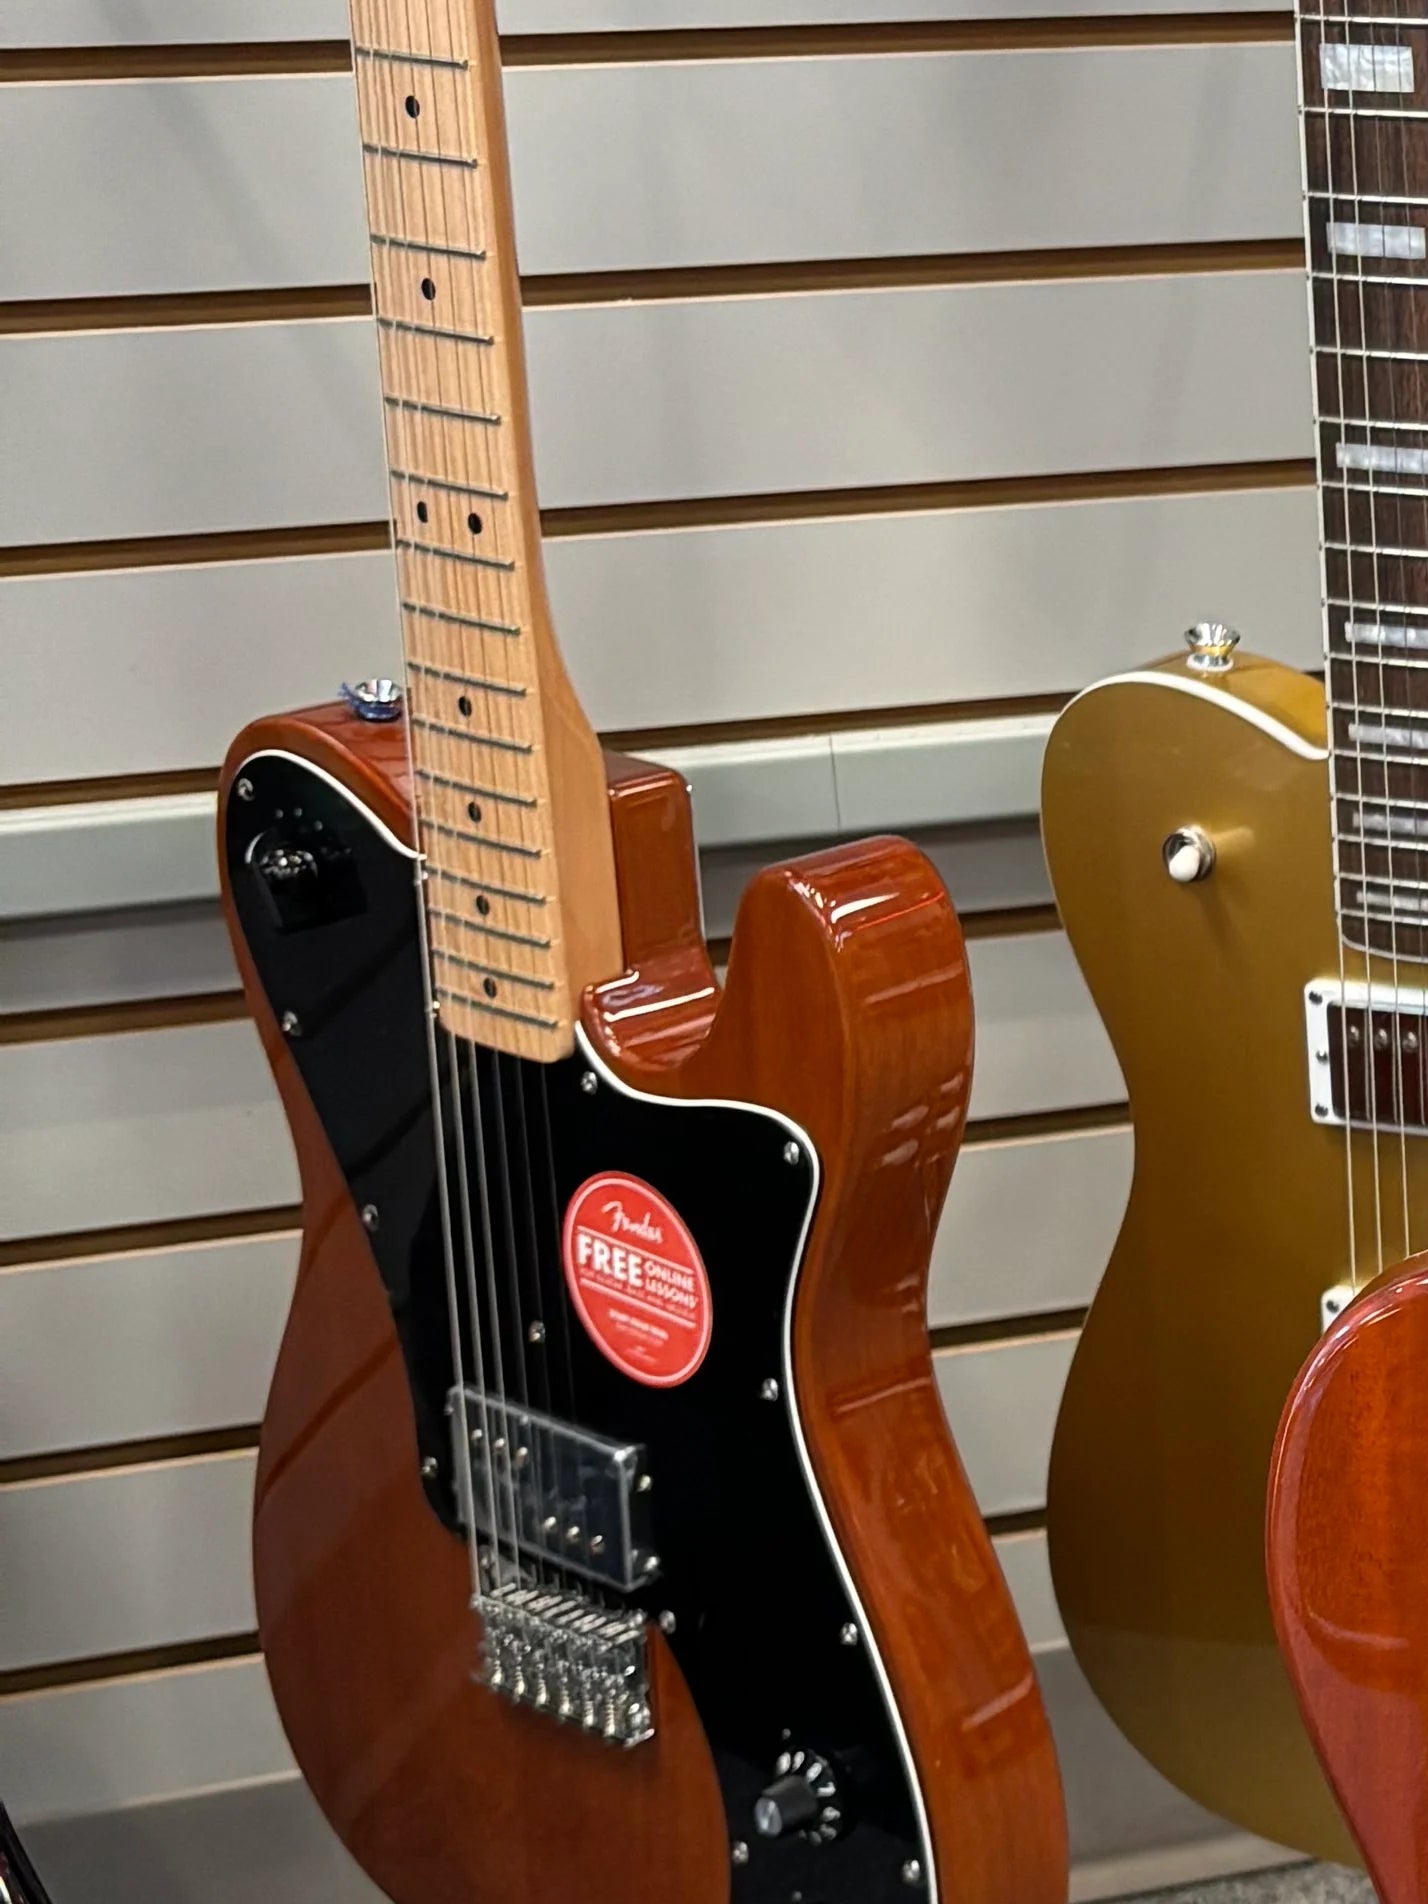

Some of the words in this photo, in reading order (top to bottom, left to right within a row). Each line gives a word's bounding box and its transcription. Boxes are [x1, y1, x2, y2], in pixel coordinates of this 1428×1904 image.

[601, 1200, 664, 1245] Fender
[575, 1233, 644, 1289] FREE
[643, 1260, 695, 1293] ONLINE
